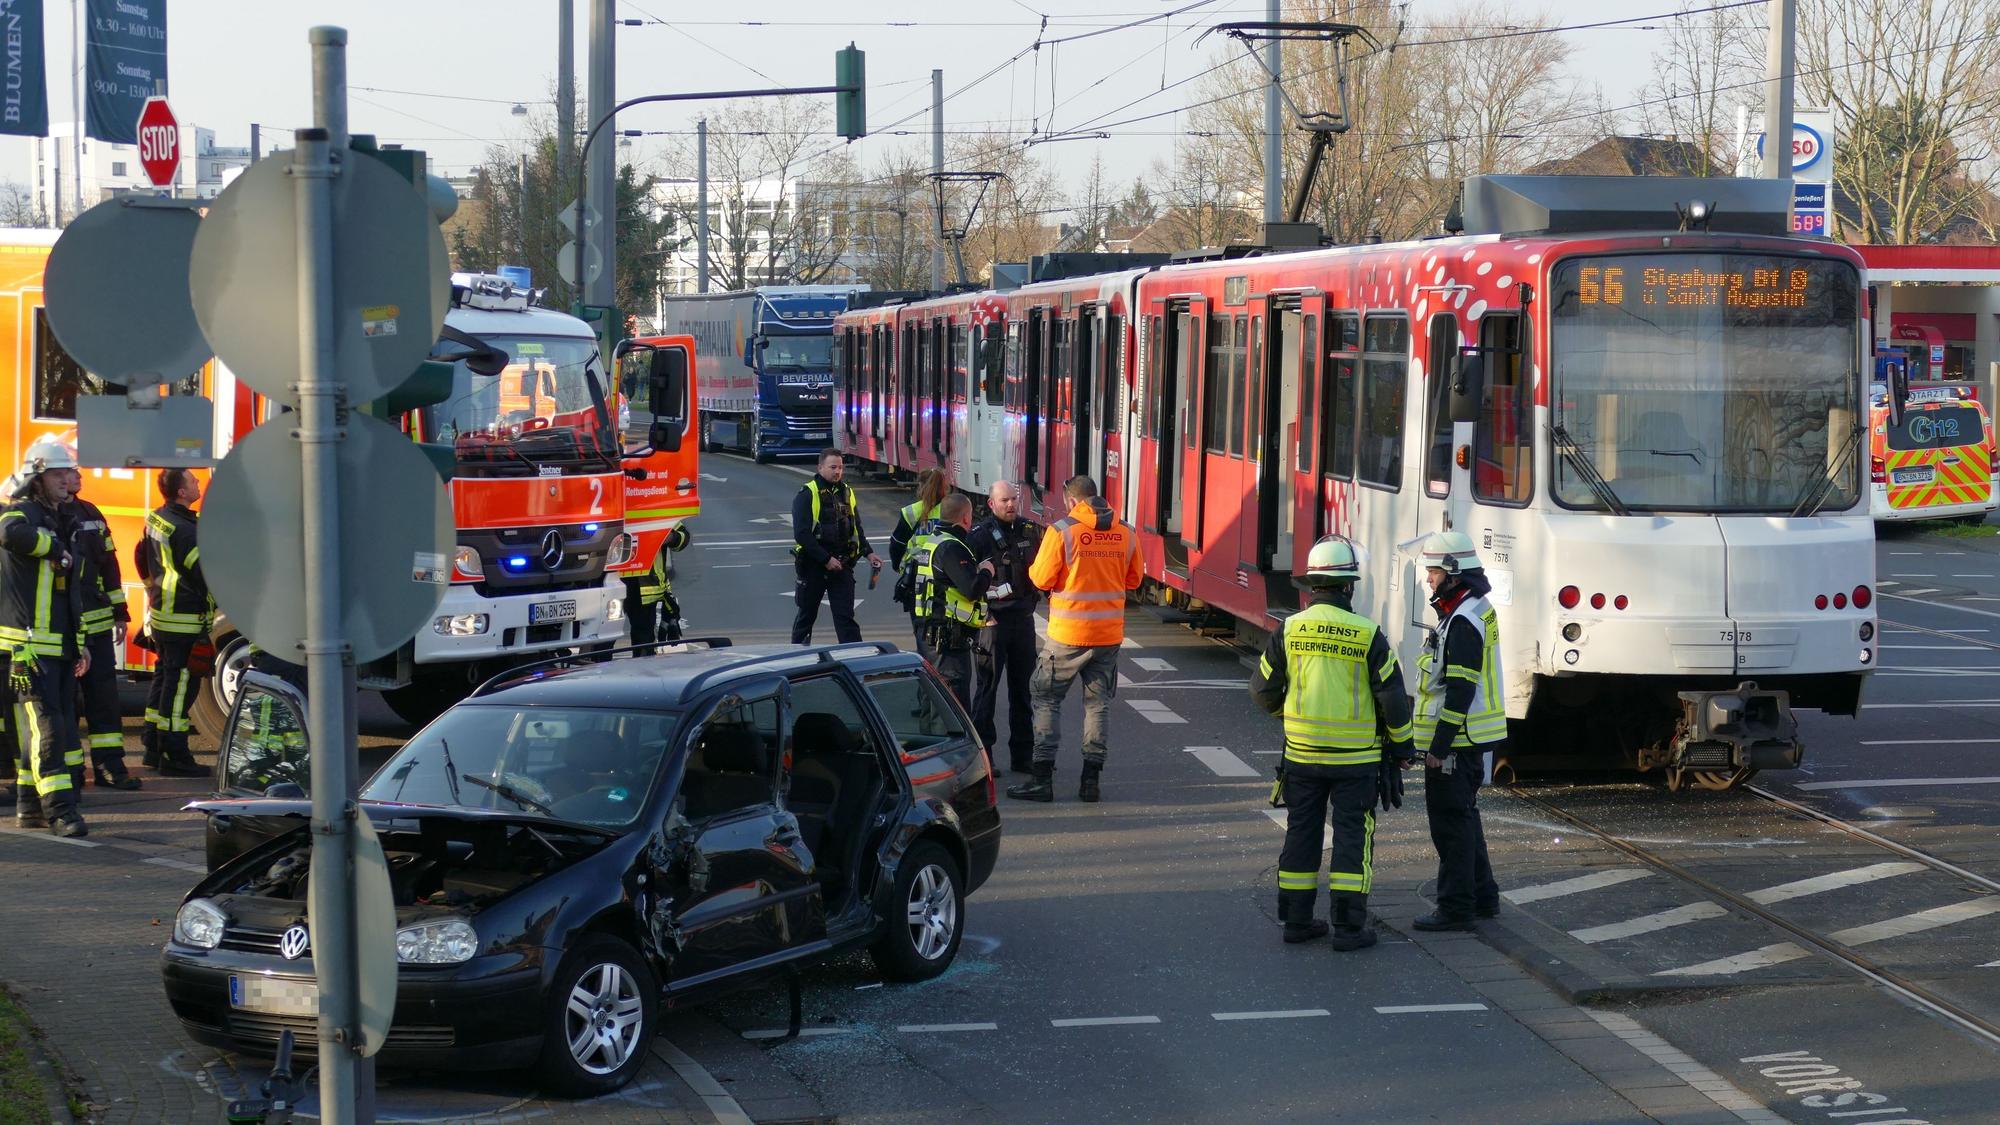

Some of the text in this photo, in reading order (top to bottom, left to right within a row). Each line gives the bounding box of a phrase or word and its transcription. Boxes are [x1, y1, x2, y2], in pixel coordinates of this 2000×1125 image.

[116, 0, 149, 20] Samstag
[96, 17, 119, 33] 8.30
[147, 26, 165, 39] Uhr
[5, 13, 21, 122] BLUMEN
[116, 62, 152, 81] Sonntag
[142, 125, 176, 161] STOP
[1792, 140, 1813, 155] SO
[1579, 267, 1624, 305] 66
[1643, 267, 1744, 290] Siegburg
[1754, 269, 1780, 288] Bf
[1666, 287, 1719, 305] Sankt
[1727, 288, 1806, 308] Augustin
[589, 478, 603, 515] 2
[626, 485, 668, 498] Rettungsdienst
[1094, 533, 1122, 541] SWB
[1494, 552, 1508, 563] 7578
[535, 602, 575, 618] BN BN 2555
[1299, 623, 1307, 633] A
[1317, 624, 1360, 639] DIENST
[1290, 641, 1366, 659] FEUERWEHR BONN
[1739, 655, 1746, 664] B
